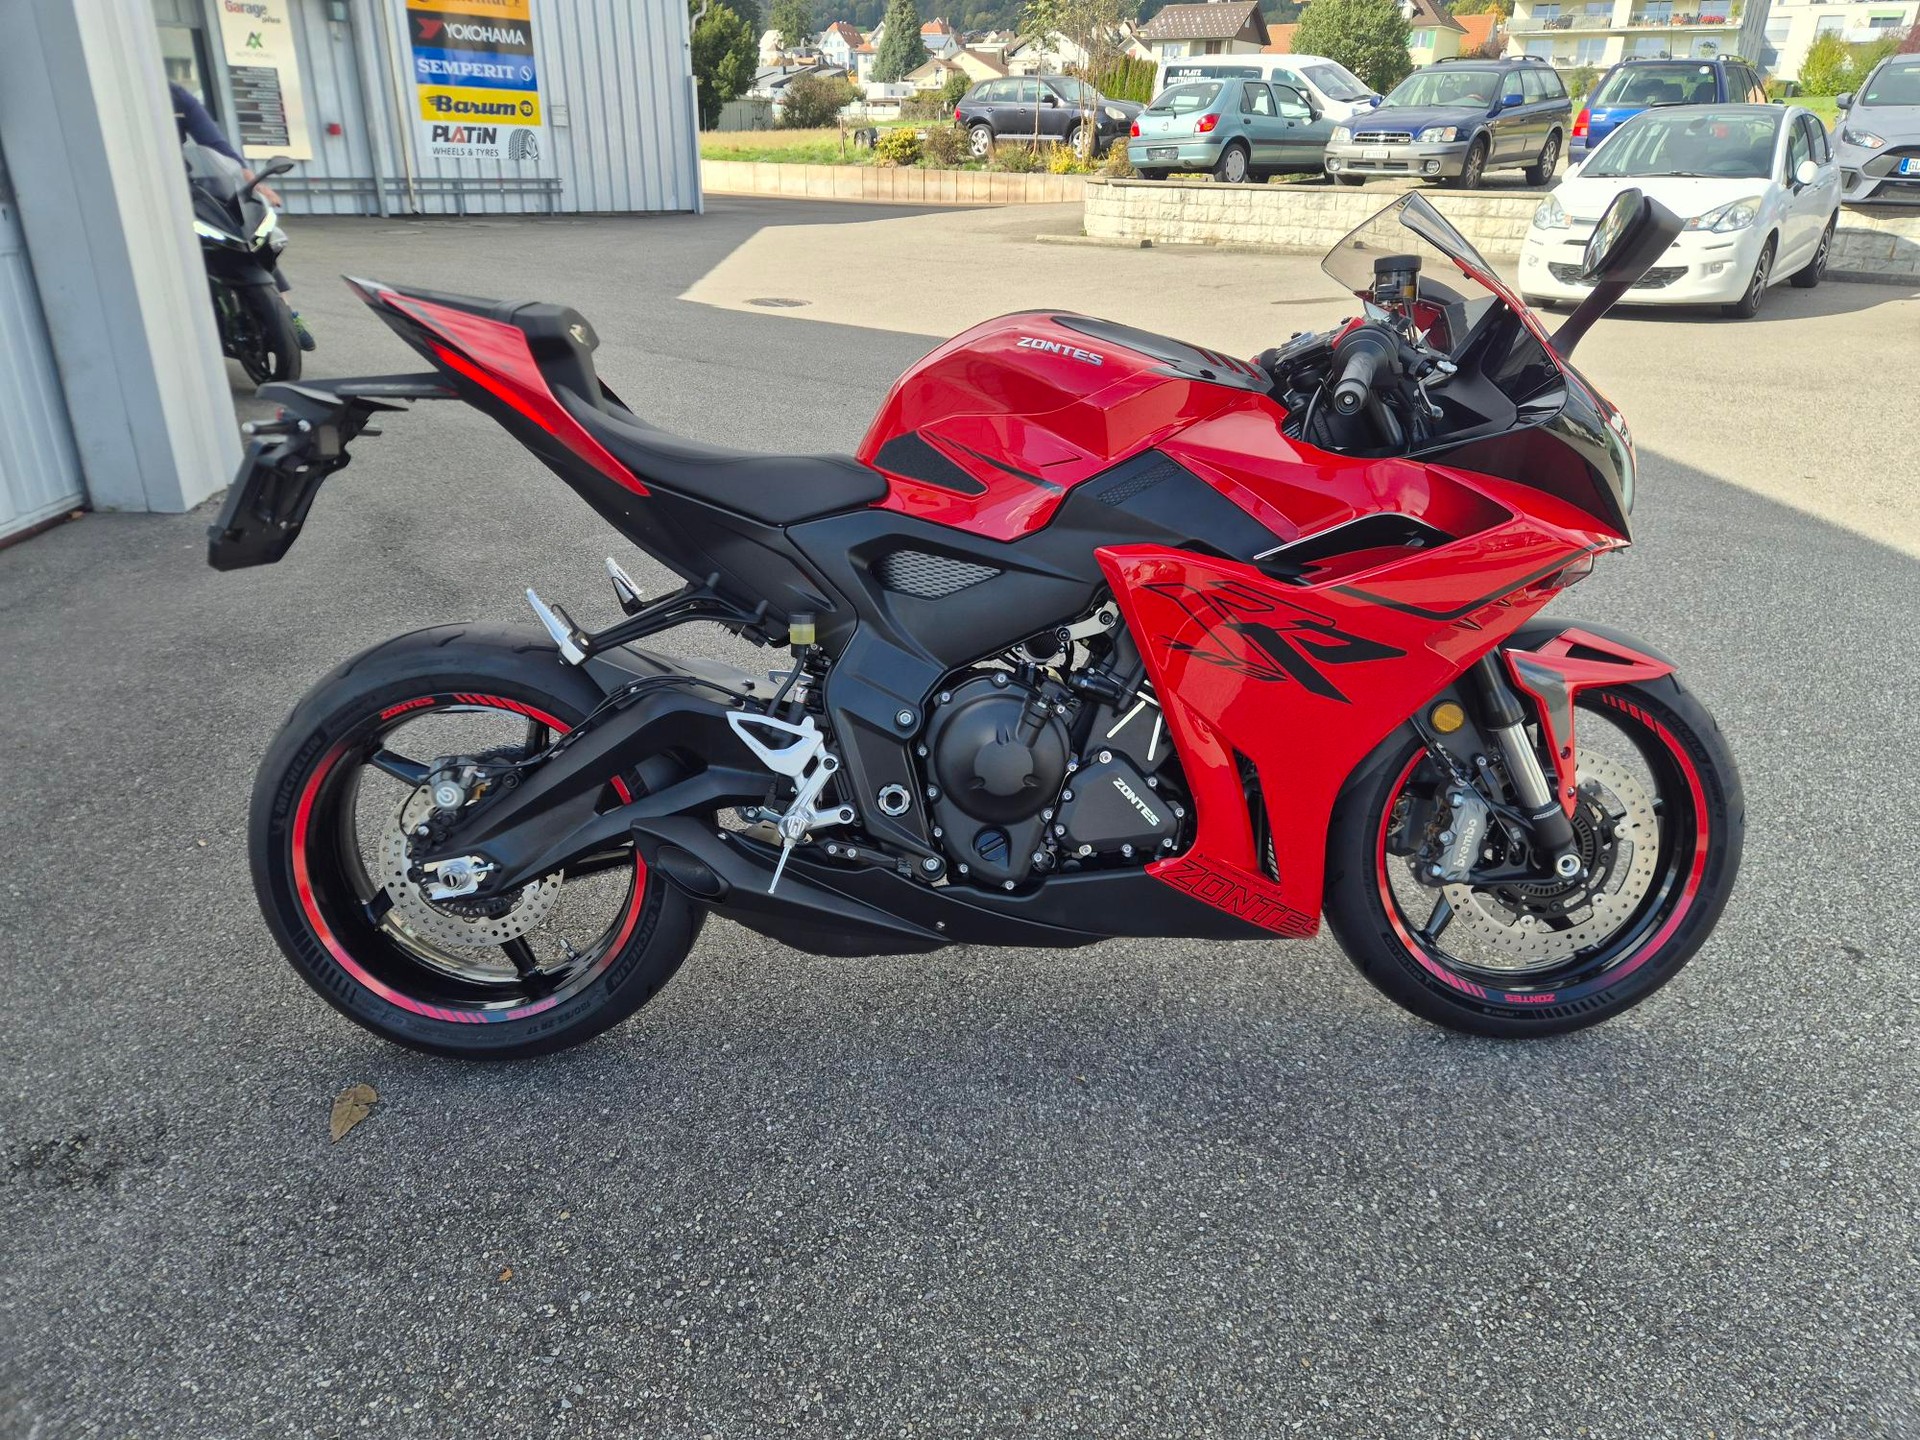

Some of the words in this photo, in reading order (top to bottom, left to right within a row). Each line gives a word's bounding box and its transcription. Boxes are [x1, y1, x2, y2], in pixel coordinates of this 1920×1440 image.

[225, 0, 267, 18] Garage
[443, 22, 526, 46] YOKOHAMA
[417, 58, 515, 79] SEMPERIT
[428, 95, 516, 116] Barum
[432, 147, 465, 156] WHEELS
[467, 148, 473, 156] &
[475, 149, 499, 157] TYRES
[1017, 336, 1104, 367] ZONTES
[274, 734, 323, 815] MICHELIN
[1113, 777, 1160, 827] ZONTES
[1455, 818, 1477, 868] brembo
[611, 912, 657, 987] MICHELIN
[1504, 993, 1556, 1003] ZONTES
